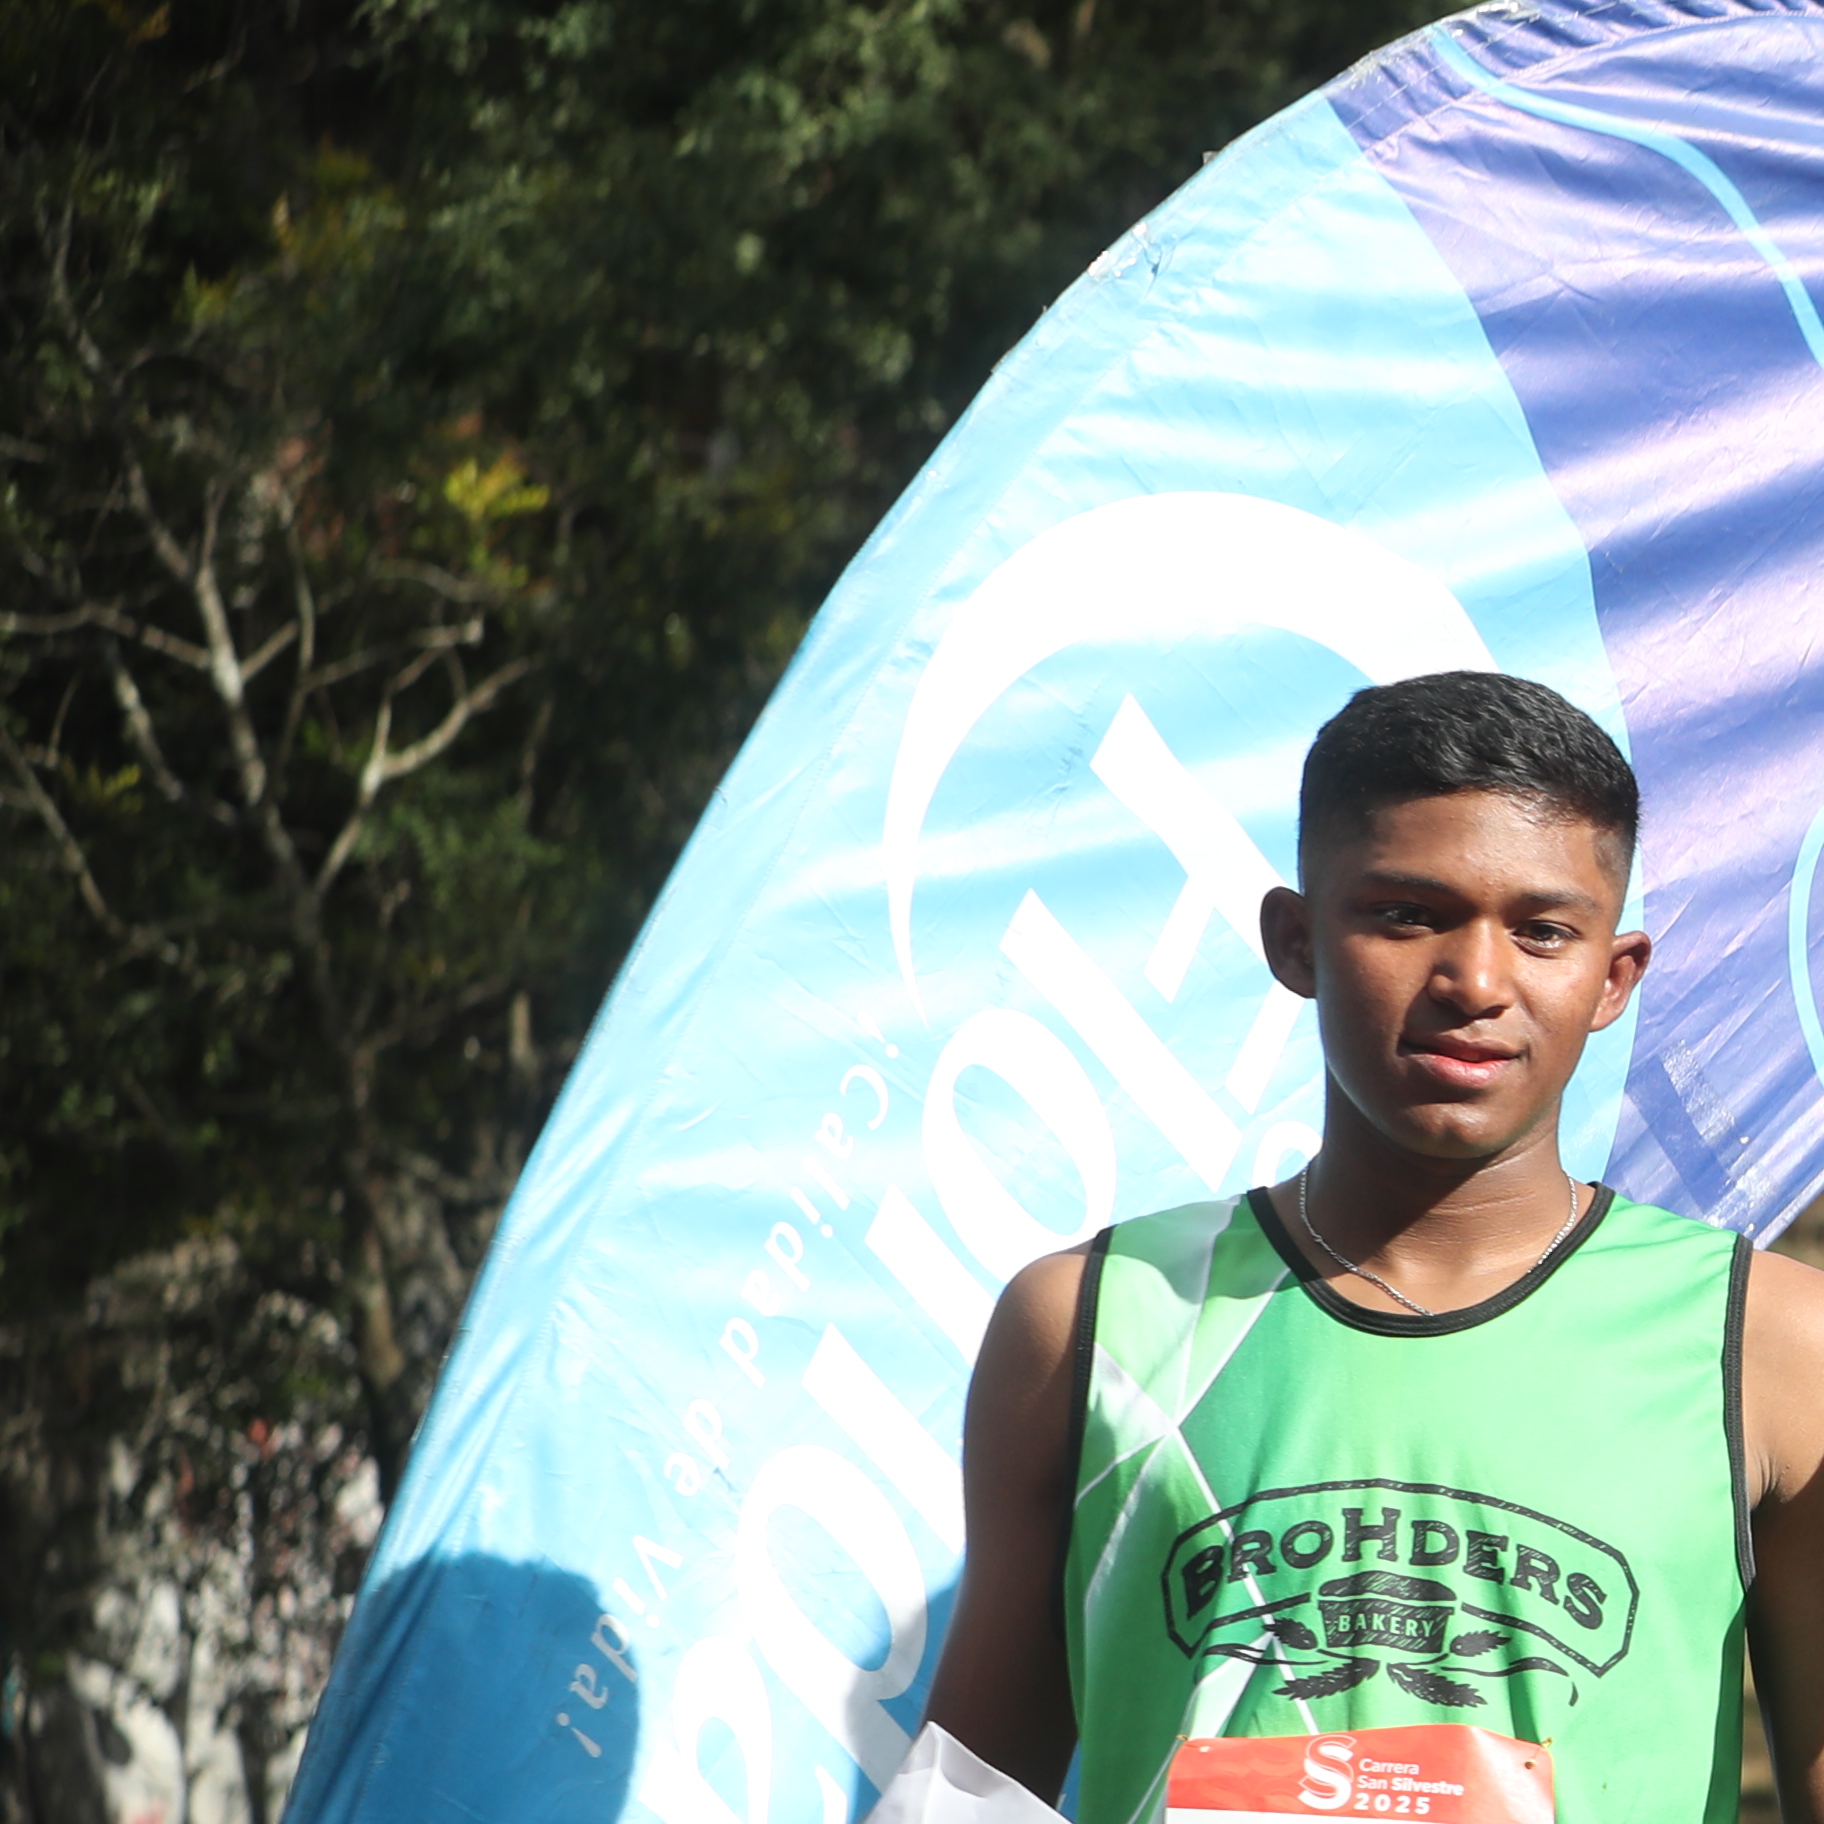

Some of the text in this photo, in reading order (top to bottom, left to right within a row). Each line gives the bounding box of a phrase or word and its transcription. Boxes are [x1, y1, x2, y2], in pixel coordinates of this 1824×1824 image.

[661, 1395, 726, 1498] de
[1184, 1506, 1608, 1630] BROHDERS
[1337, 1613, 1435, 1640] BAKERY
[554, 1530, 687, 1761] Vida!
[1359, 1758, 1420, 1775] Carrera
[1357, 1775, 1465, 1796] San Silvestre
[1354, 1793, 1430, 1815] 2025
